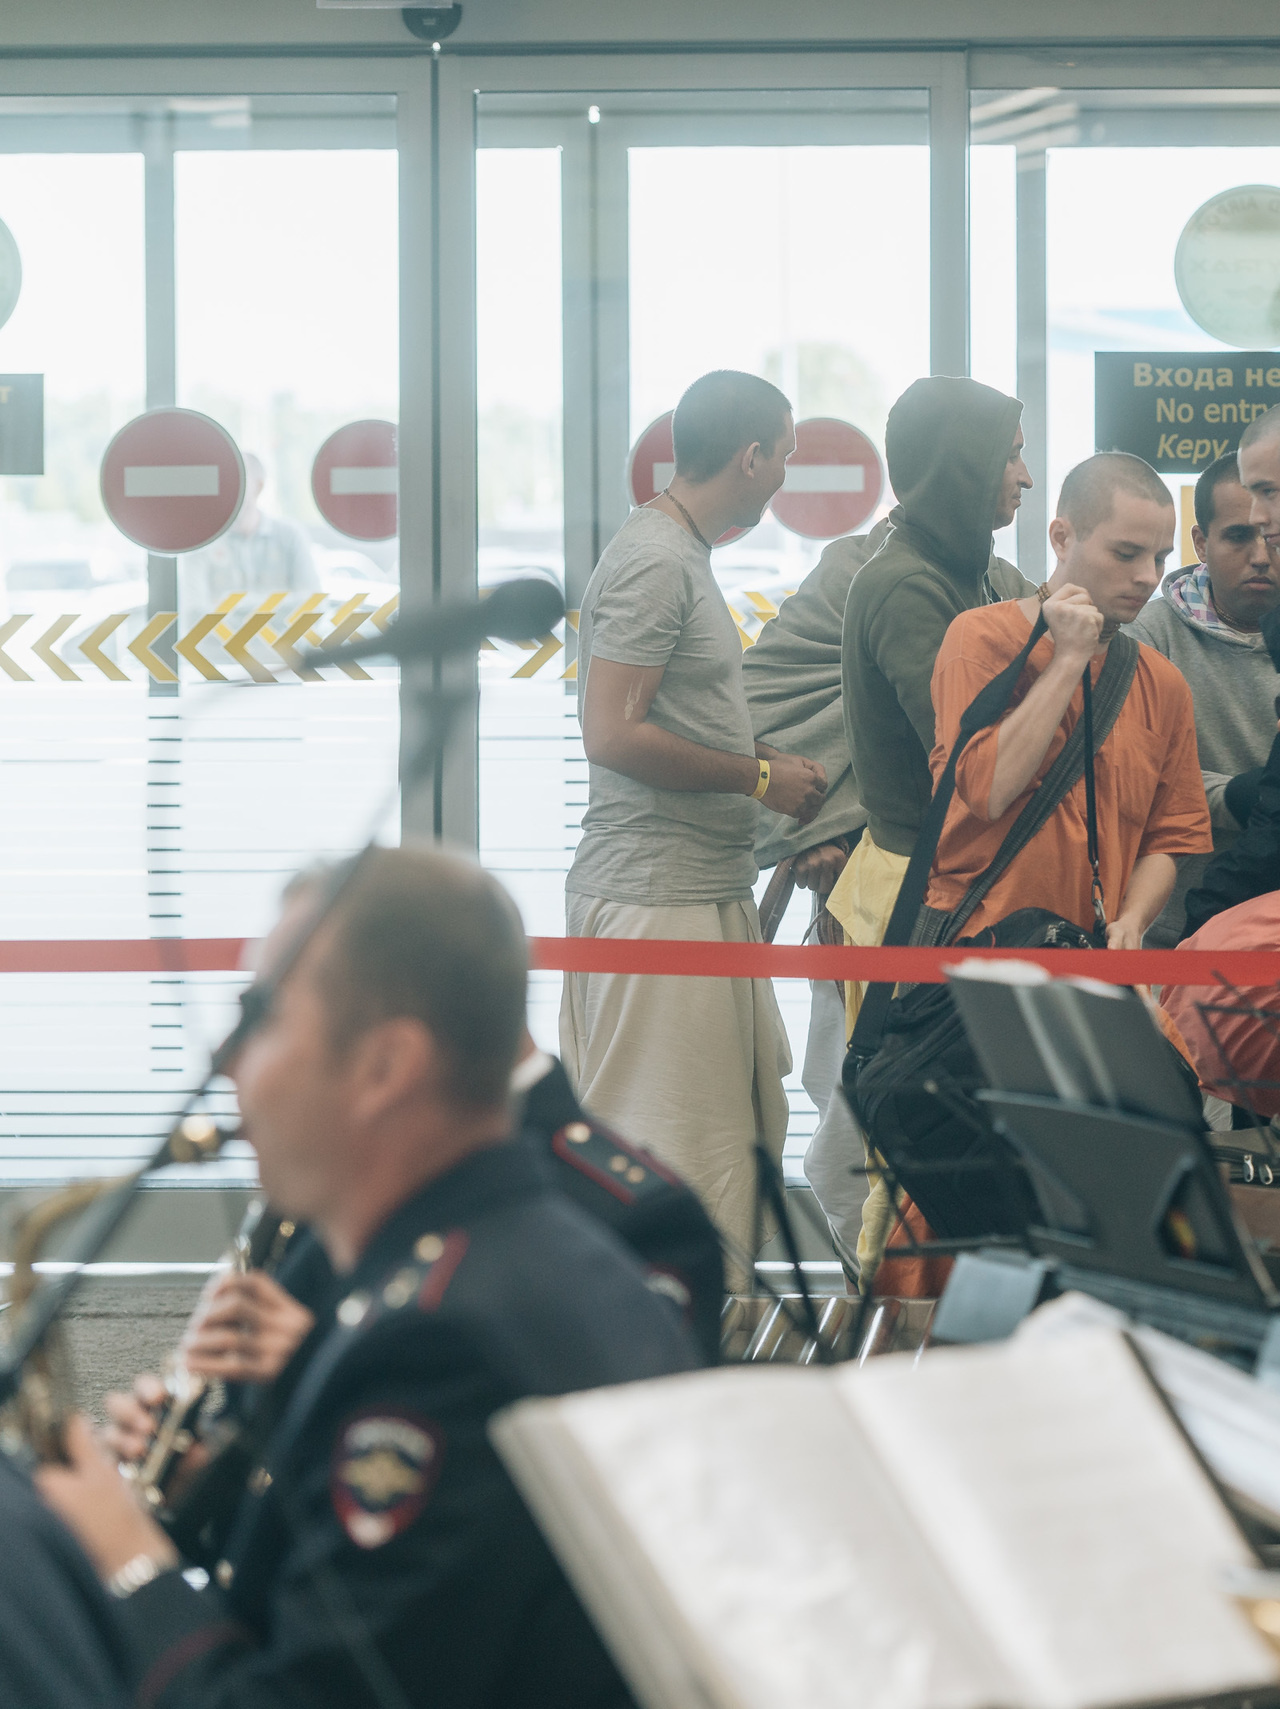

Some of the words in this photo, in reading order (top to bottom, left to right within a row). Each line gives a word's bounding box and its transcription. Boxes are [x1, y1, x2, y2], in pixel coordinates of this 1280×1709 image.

[1133, 362, 1234, 391] Входа
[1156, 397, 1194, 424] No
[1203, 398, 1278, 424] entr
